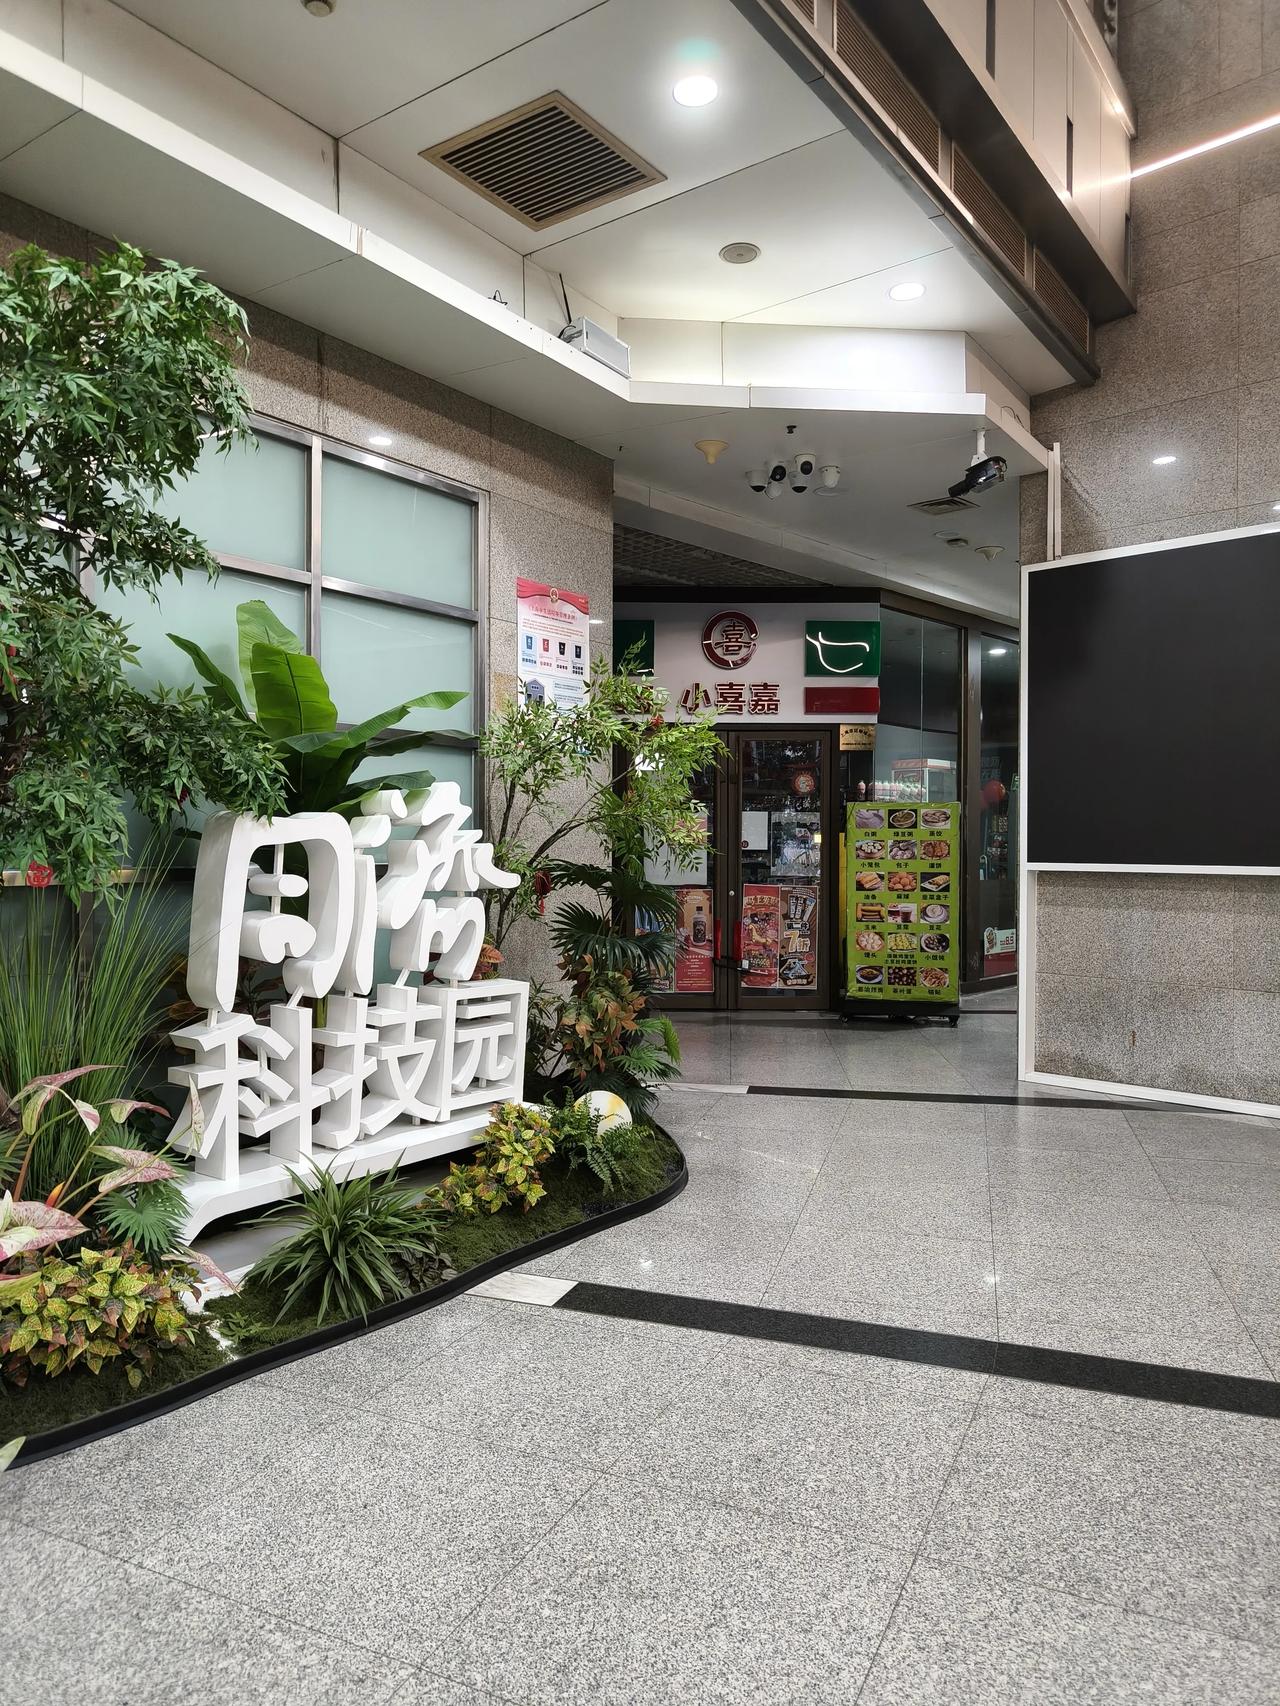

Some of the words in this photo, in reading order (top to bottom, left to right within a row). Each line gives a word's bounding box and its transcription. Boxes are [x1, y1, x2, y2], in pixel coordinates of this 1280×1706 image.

[714, 618, 753, 655] 喜
[680, 682, 781, 715] 小喜嘉
[187, 781, 521, 1013] 同济
[165, 978, 530, 1181] 科技园
